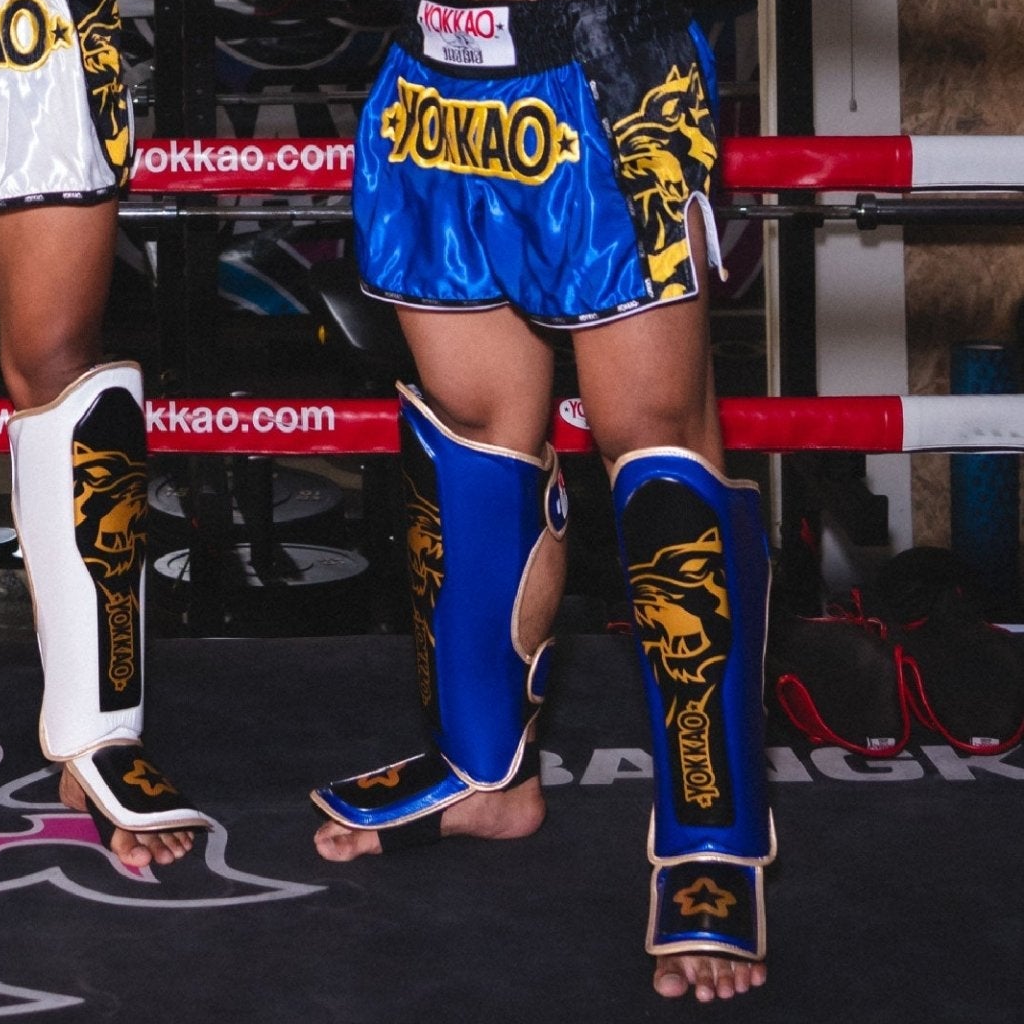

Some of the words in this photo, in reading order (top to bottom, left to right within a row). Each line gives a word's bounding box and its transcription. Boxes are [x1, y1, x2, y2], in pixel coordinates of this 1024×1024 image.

[424, 3, 495, 39] YOKKAO
[388, 79, 555, 182] YOKKAO
[106, 595, 134, 679] YOKKAO
[677, 710, 719, 802] YOKKAO
